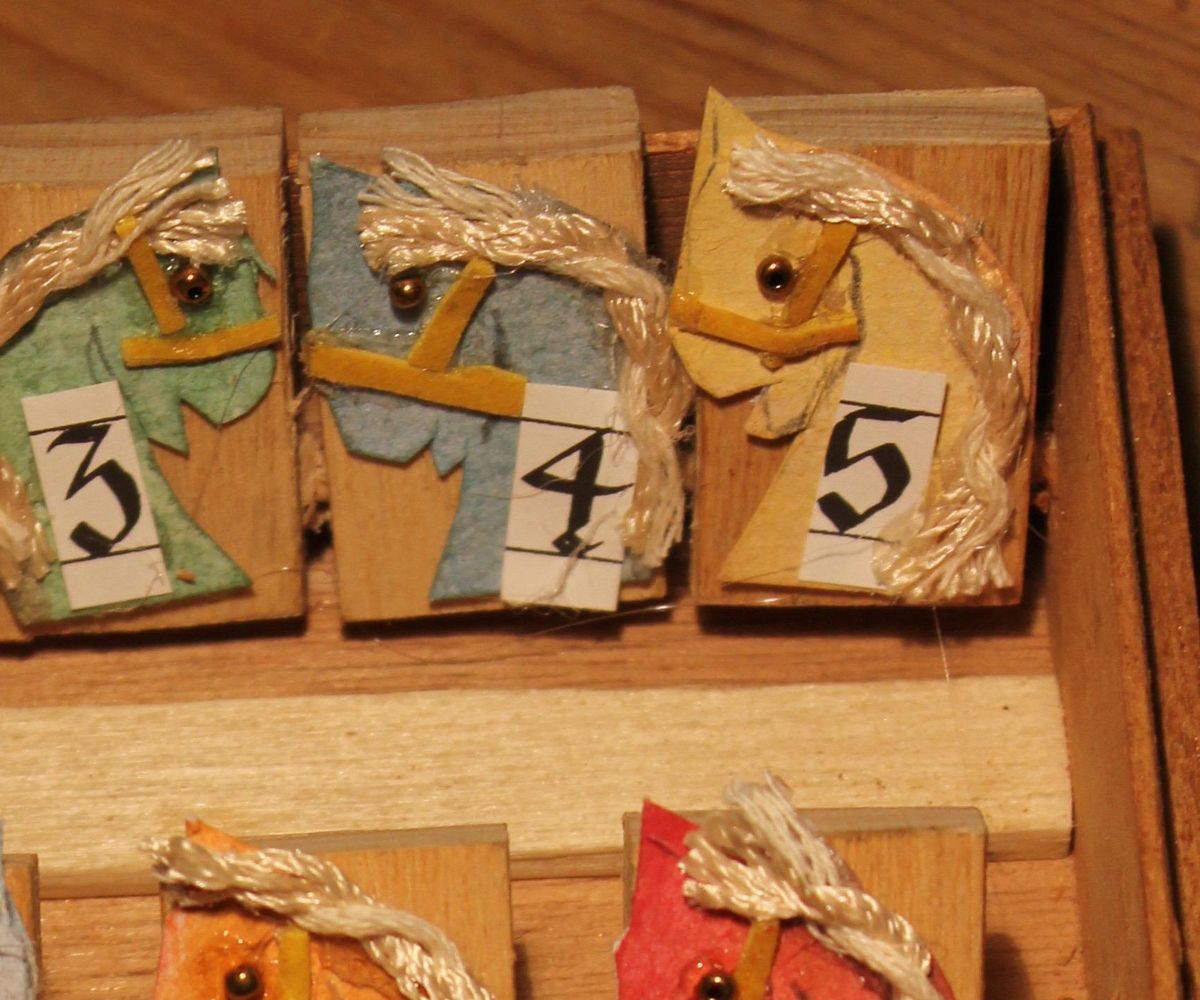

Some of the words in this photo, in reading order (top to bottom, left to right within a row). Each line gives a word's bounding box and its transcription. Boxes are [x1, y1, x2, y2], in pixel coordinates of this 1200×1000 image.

[46, 421, 142, 555] 3
[522, 427, 634, 557] 4
[817, 405, 929, 533] 5
